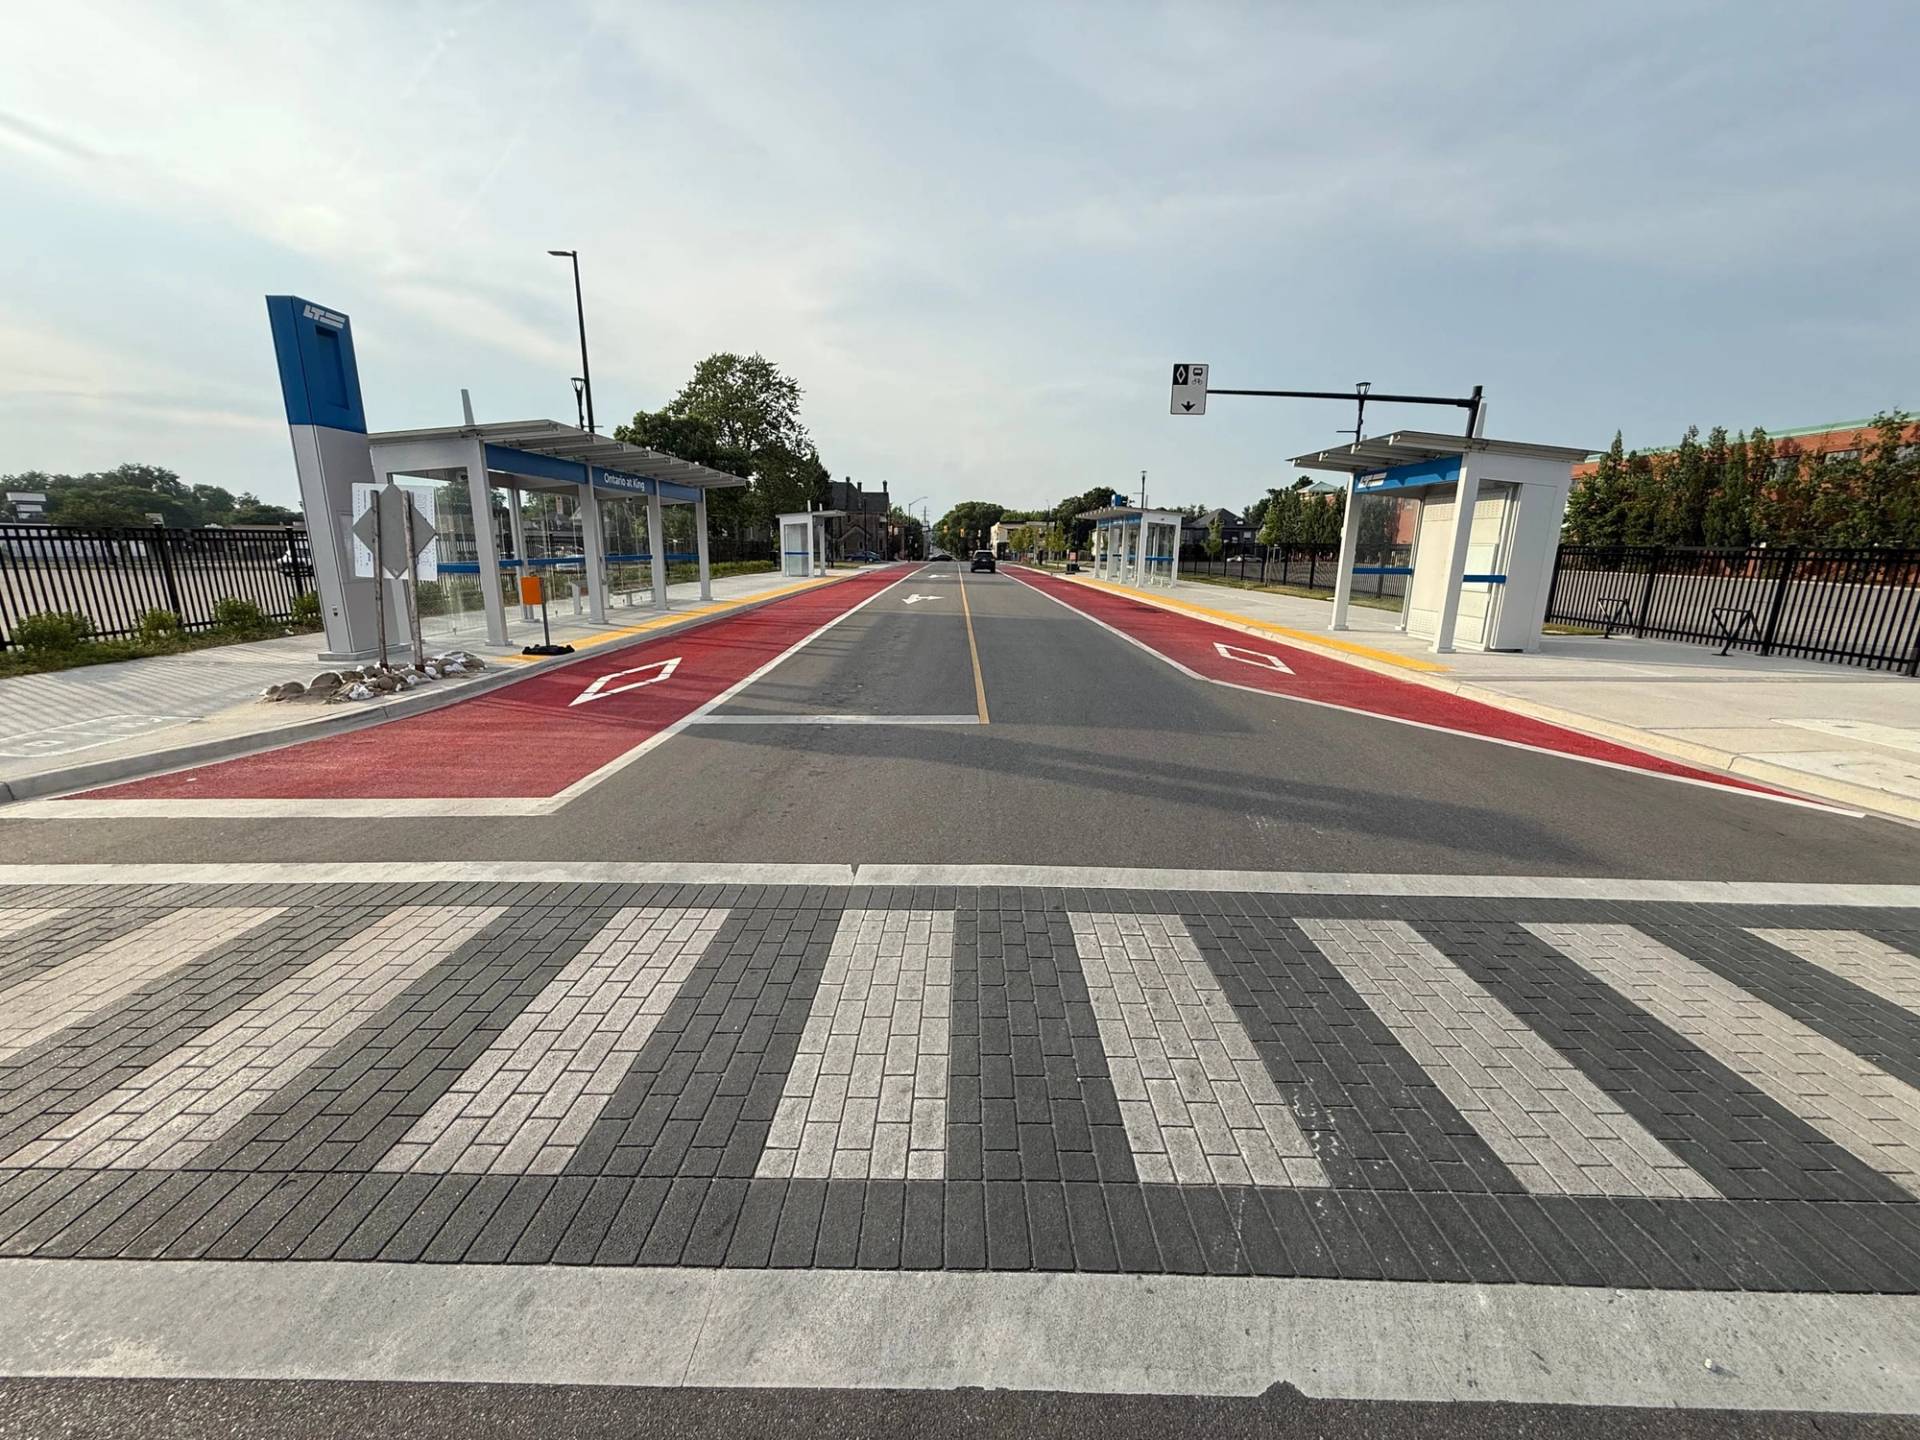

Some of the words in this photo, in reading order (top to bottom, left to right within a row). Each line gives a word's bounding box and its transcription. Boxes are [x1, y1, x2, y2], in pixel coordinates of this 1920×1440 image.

[603, 472, 626, 487] Ontario
[626, 478, 633, 488] at
[633, 478, 646, 492] King
